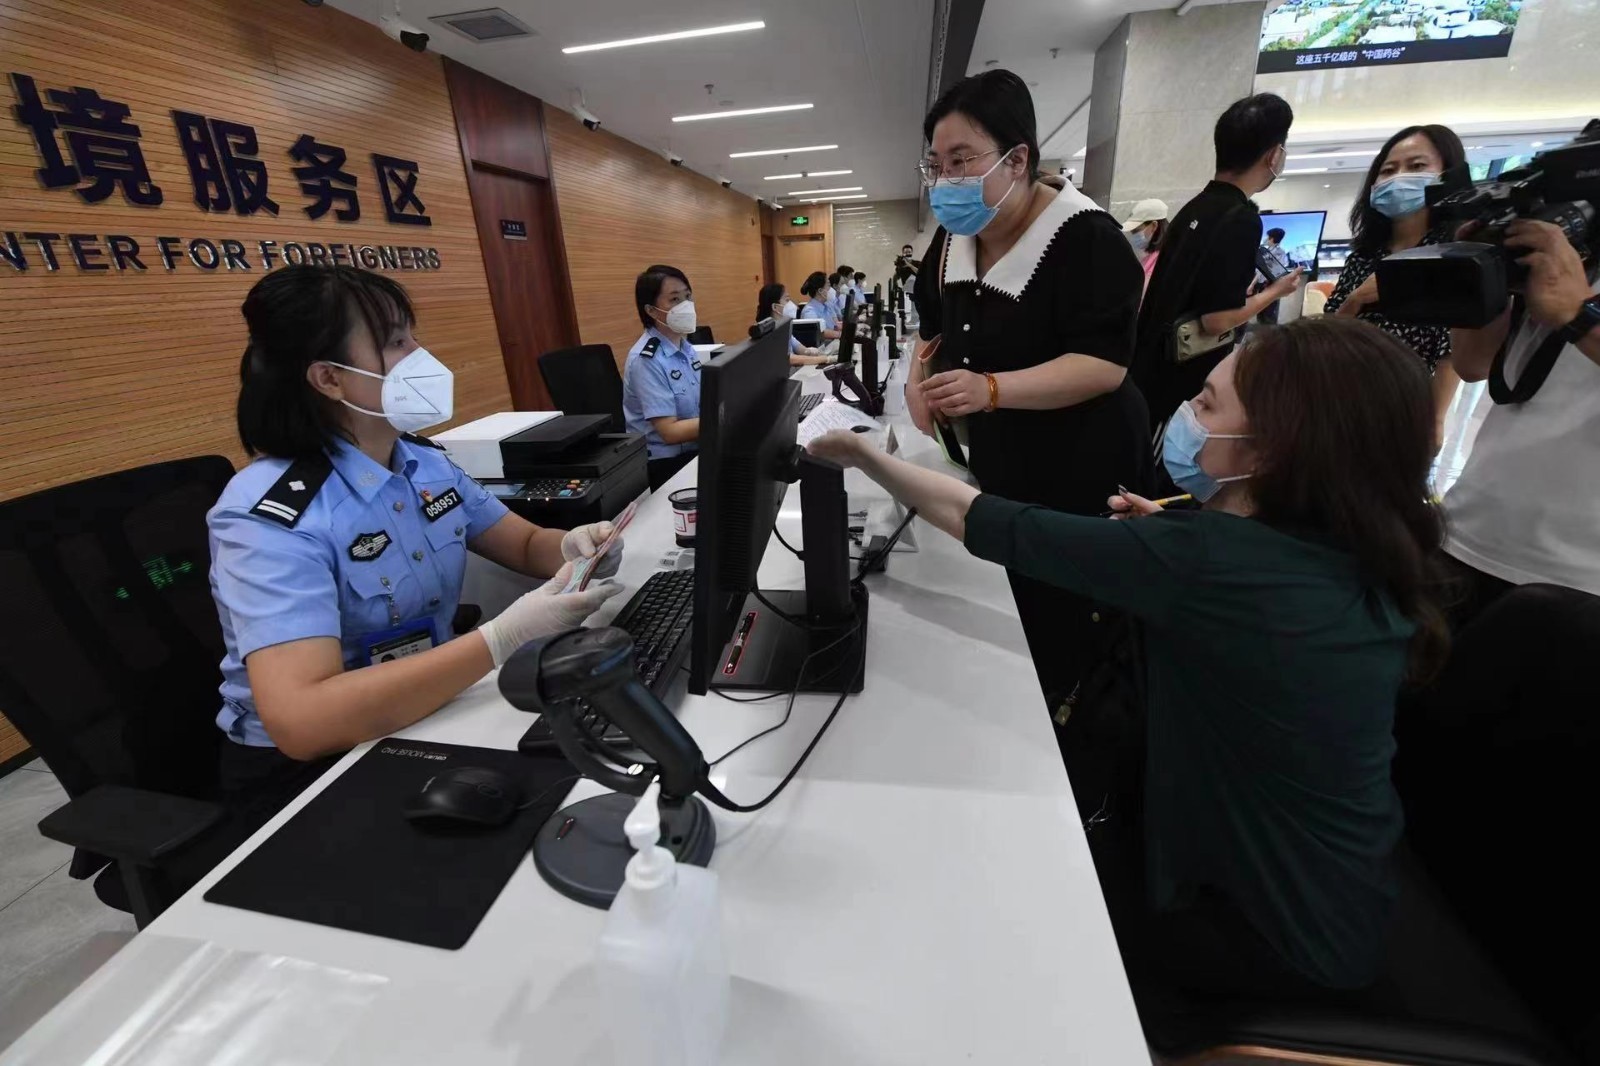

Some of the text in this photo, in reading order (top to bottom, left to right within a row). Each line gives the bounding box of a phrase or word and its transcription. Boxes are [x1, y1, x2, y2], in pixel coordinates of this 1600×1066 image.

[10, 72, 431, 226] 境服务区
[157, 236, 251, 271] FOR
[259, 240, 440, 270] FOREIGNERS
[426, 491, 458, 517] 058957
